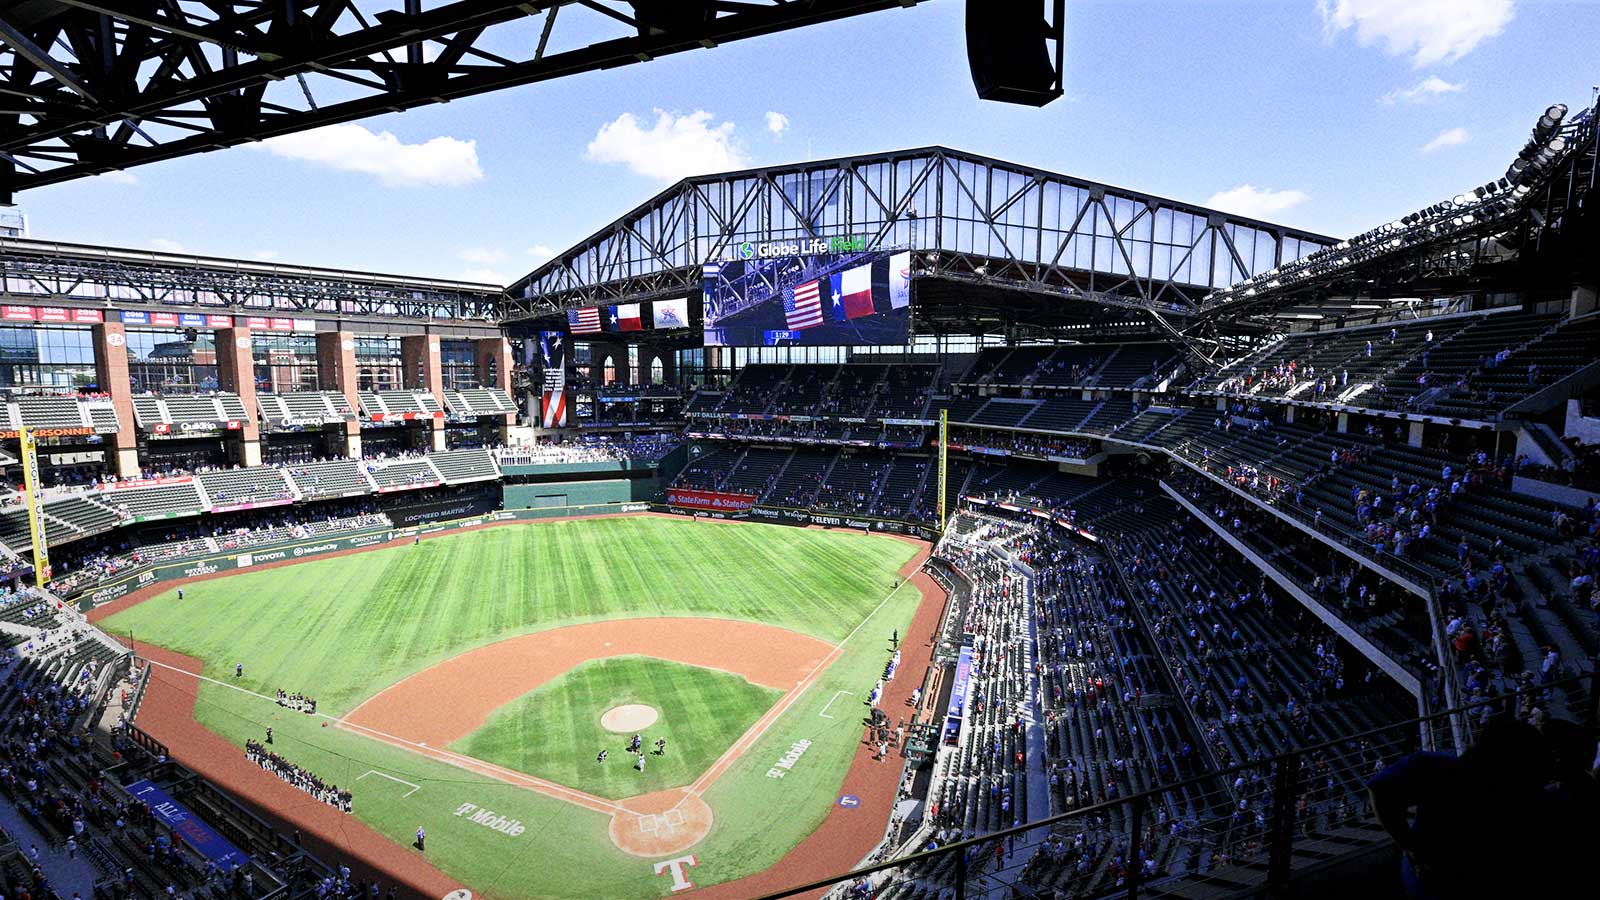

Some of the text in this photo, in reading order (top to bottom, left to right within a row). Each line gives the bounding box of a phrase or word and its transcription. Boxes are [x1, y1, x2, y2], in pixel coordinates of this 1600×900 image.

[758, 236, 865, 257] Globe Life Field
[34, 428, 96, 437] ERSONNEL
[722, 499, 751, 510] StateFar
[404, 508, 466, 523] LOCKHEED MARTIN
[253, 551, 286, 562] TOYOTA
[138, 571, 155, 583] UTA
[774, 739, 812, 770] Mobile
[466, 807, 526, 836] Mobile
[653, 854, 700, 894] T
